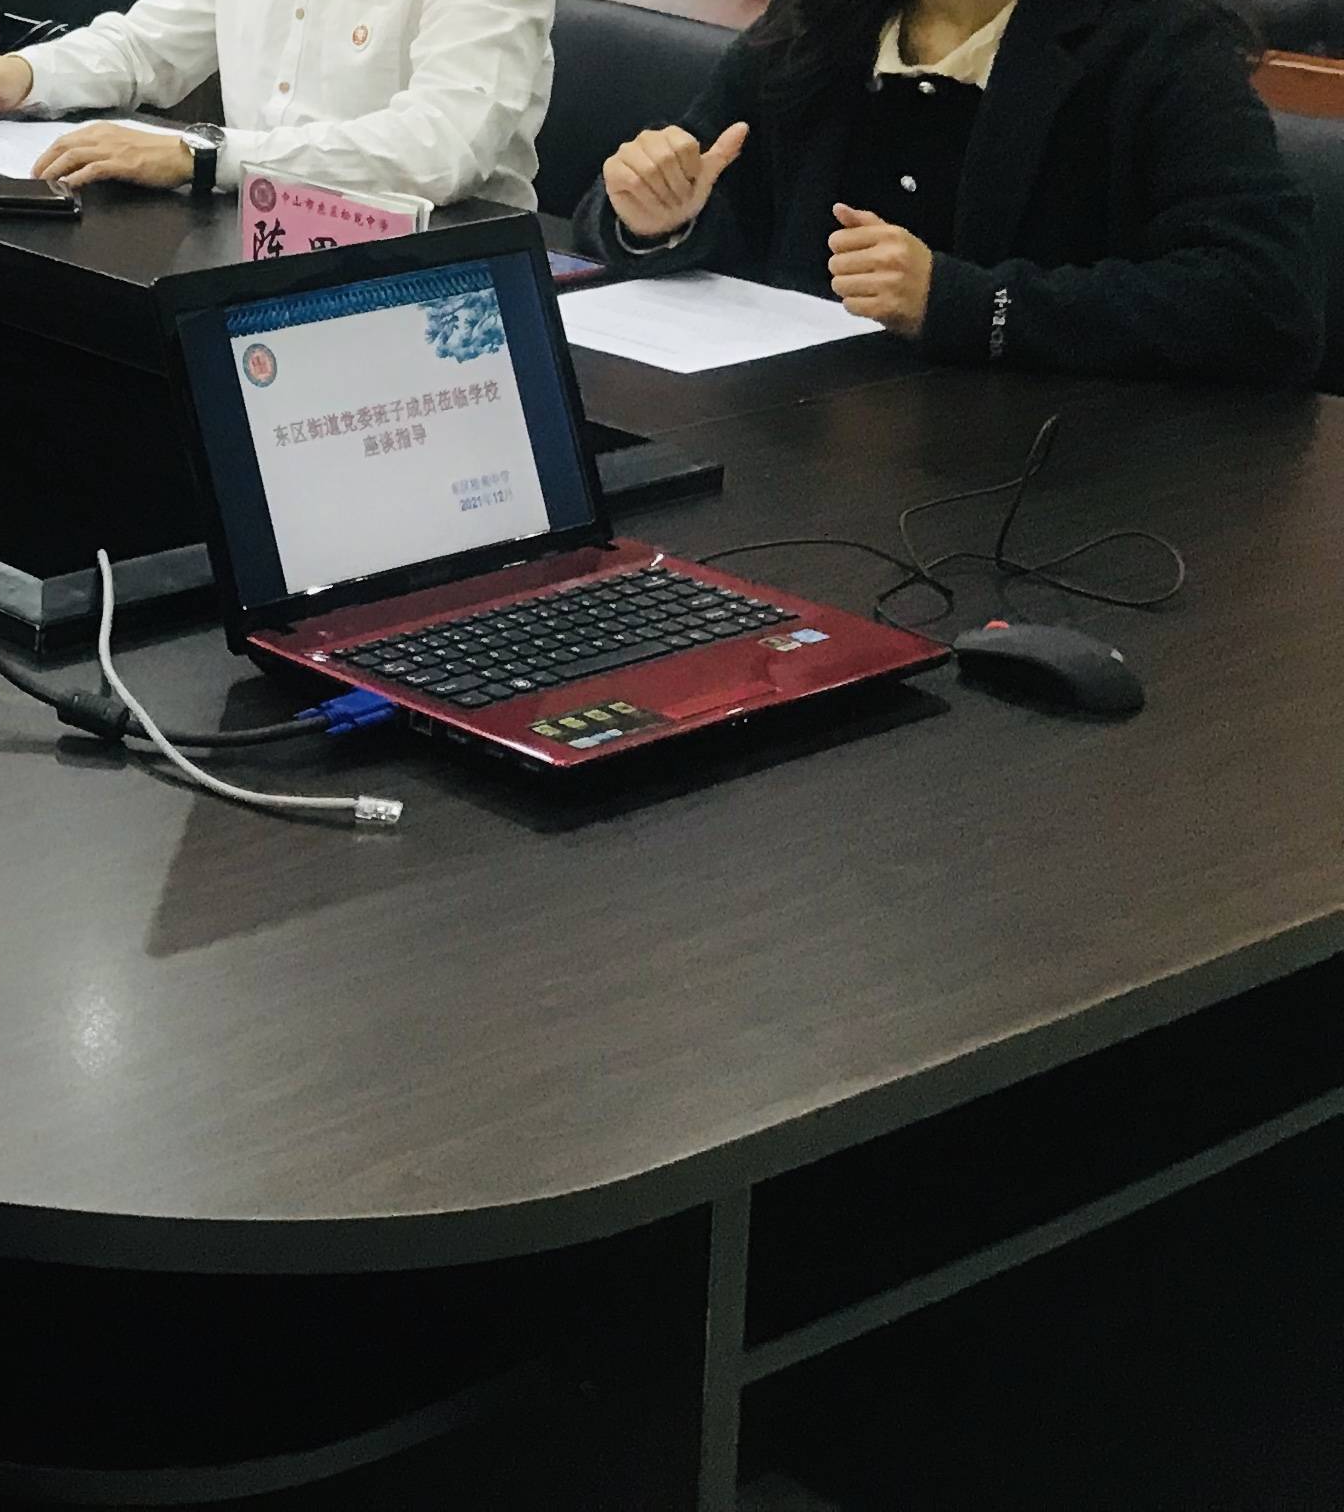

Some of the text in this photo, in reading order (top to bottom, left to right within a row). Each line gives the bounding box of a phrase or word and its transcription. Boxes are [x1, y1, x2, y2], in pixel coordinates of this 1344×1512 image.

[273, 380, 501, 448] 东区街道党委班子成员莅临学校
[362, 424, 428, 457] 座谈指导
